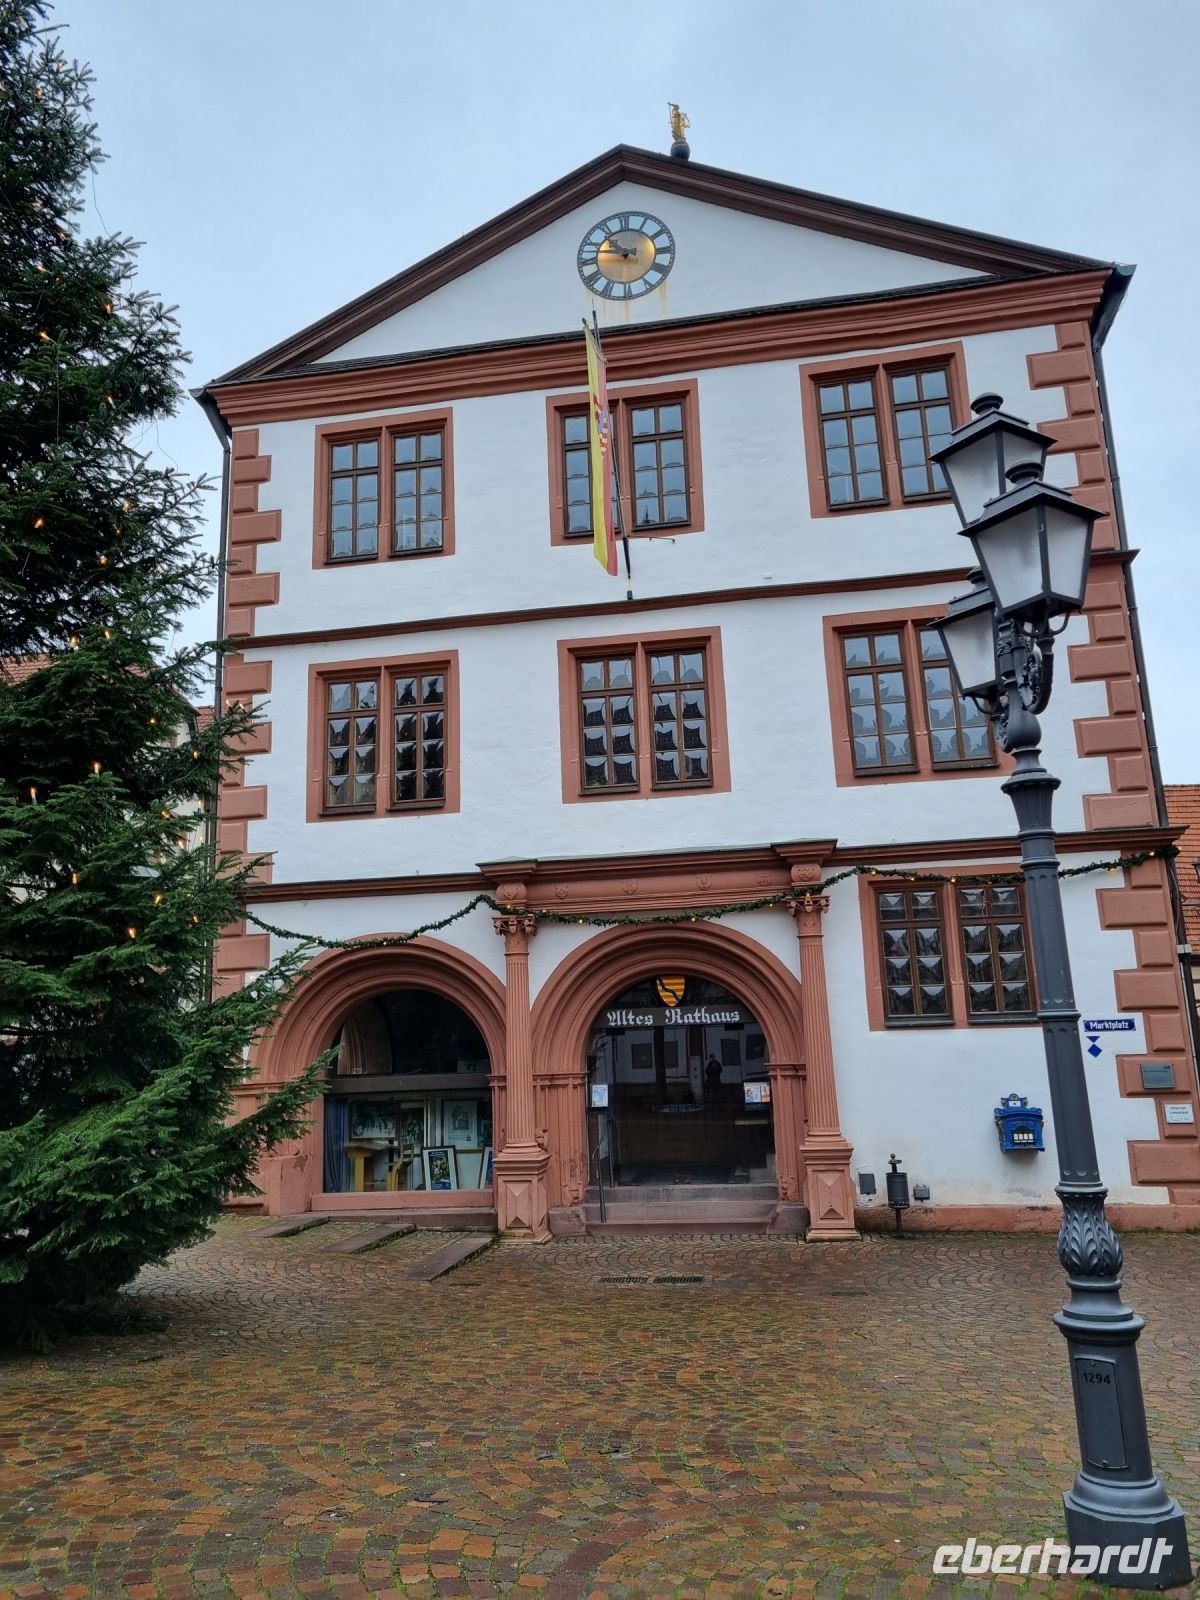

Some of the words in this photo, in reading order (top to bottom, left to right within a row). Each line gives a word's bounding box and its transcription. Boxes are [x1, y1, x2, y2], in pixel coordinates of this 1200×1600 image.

[607, 1009, 653, 1026] Altes
[665, 1006, 740, 1024] Rathaus
[1090, 1020, 1129, 1030] Marktplatz
[1083, 1372, 1112, 1385] 1294
